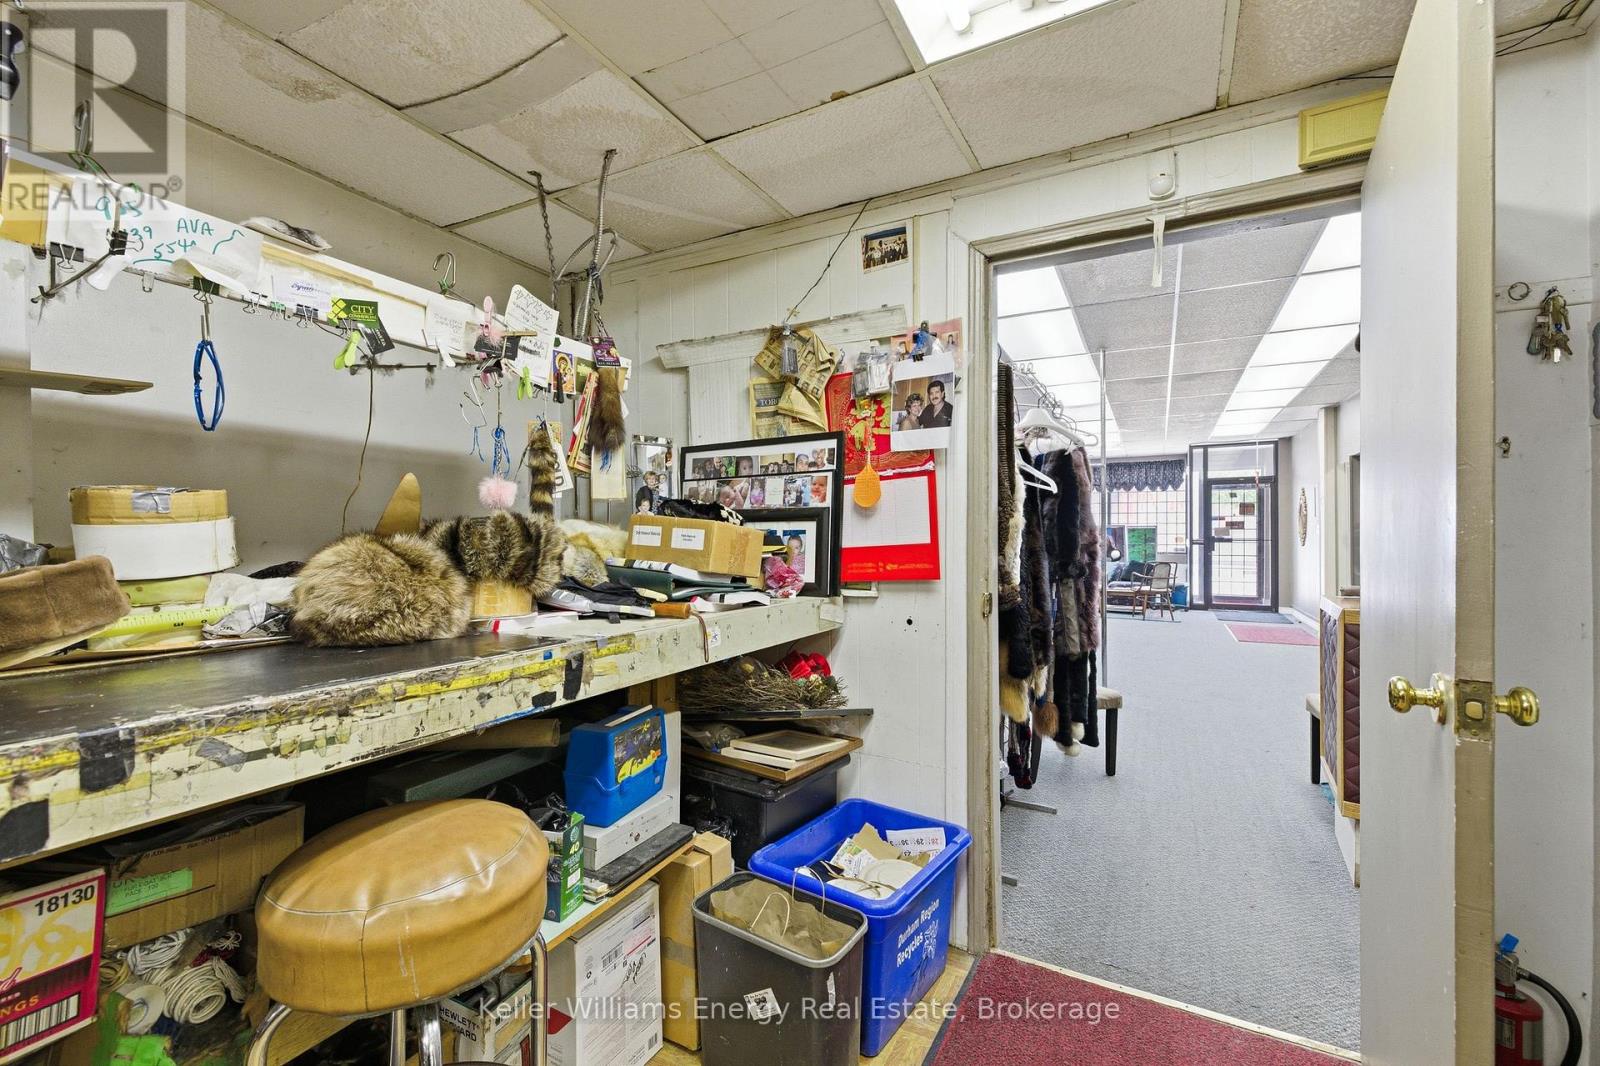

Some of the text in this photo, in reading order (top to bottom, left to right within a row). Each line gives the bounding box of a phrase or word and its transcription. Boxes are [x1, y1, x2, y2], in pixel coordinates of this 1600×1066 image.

[177, 218, 214, 236] AVA
[350, 304, 376, 313] CITY
[35, 885, 95, 916] 18130
[896, 932, 924, 968] Recycles
